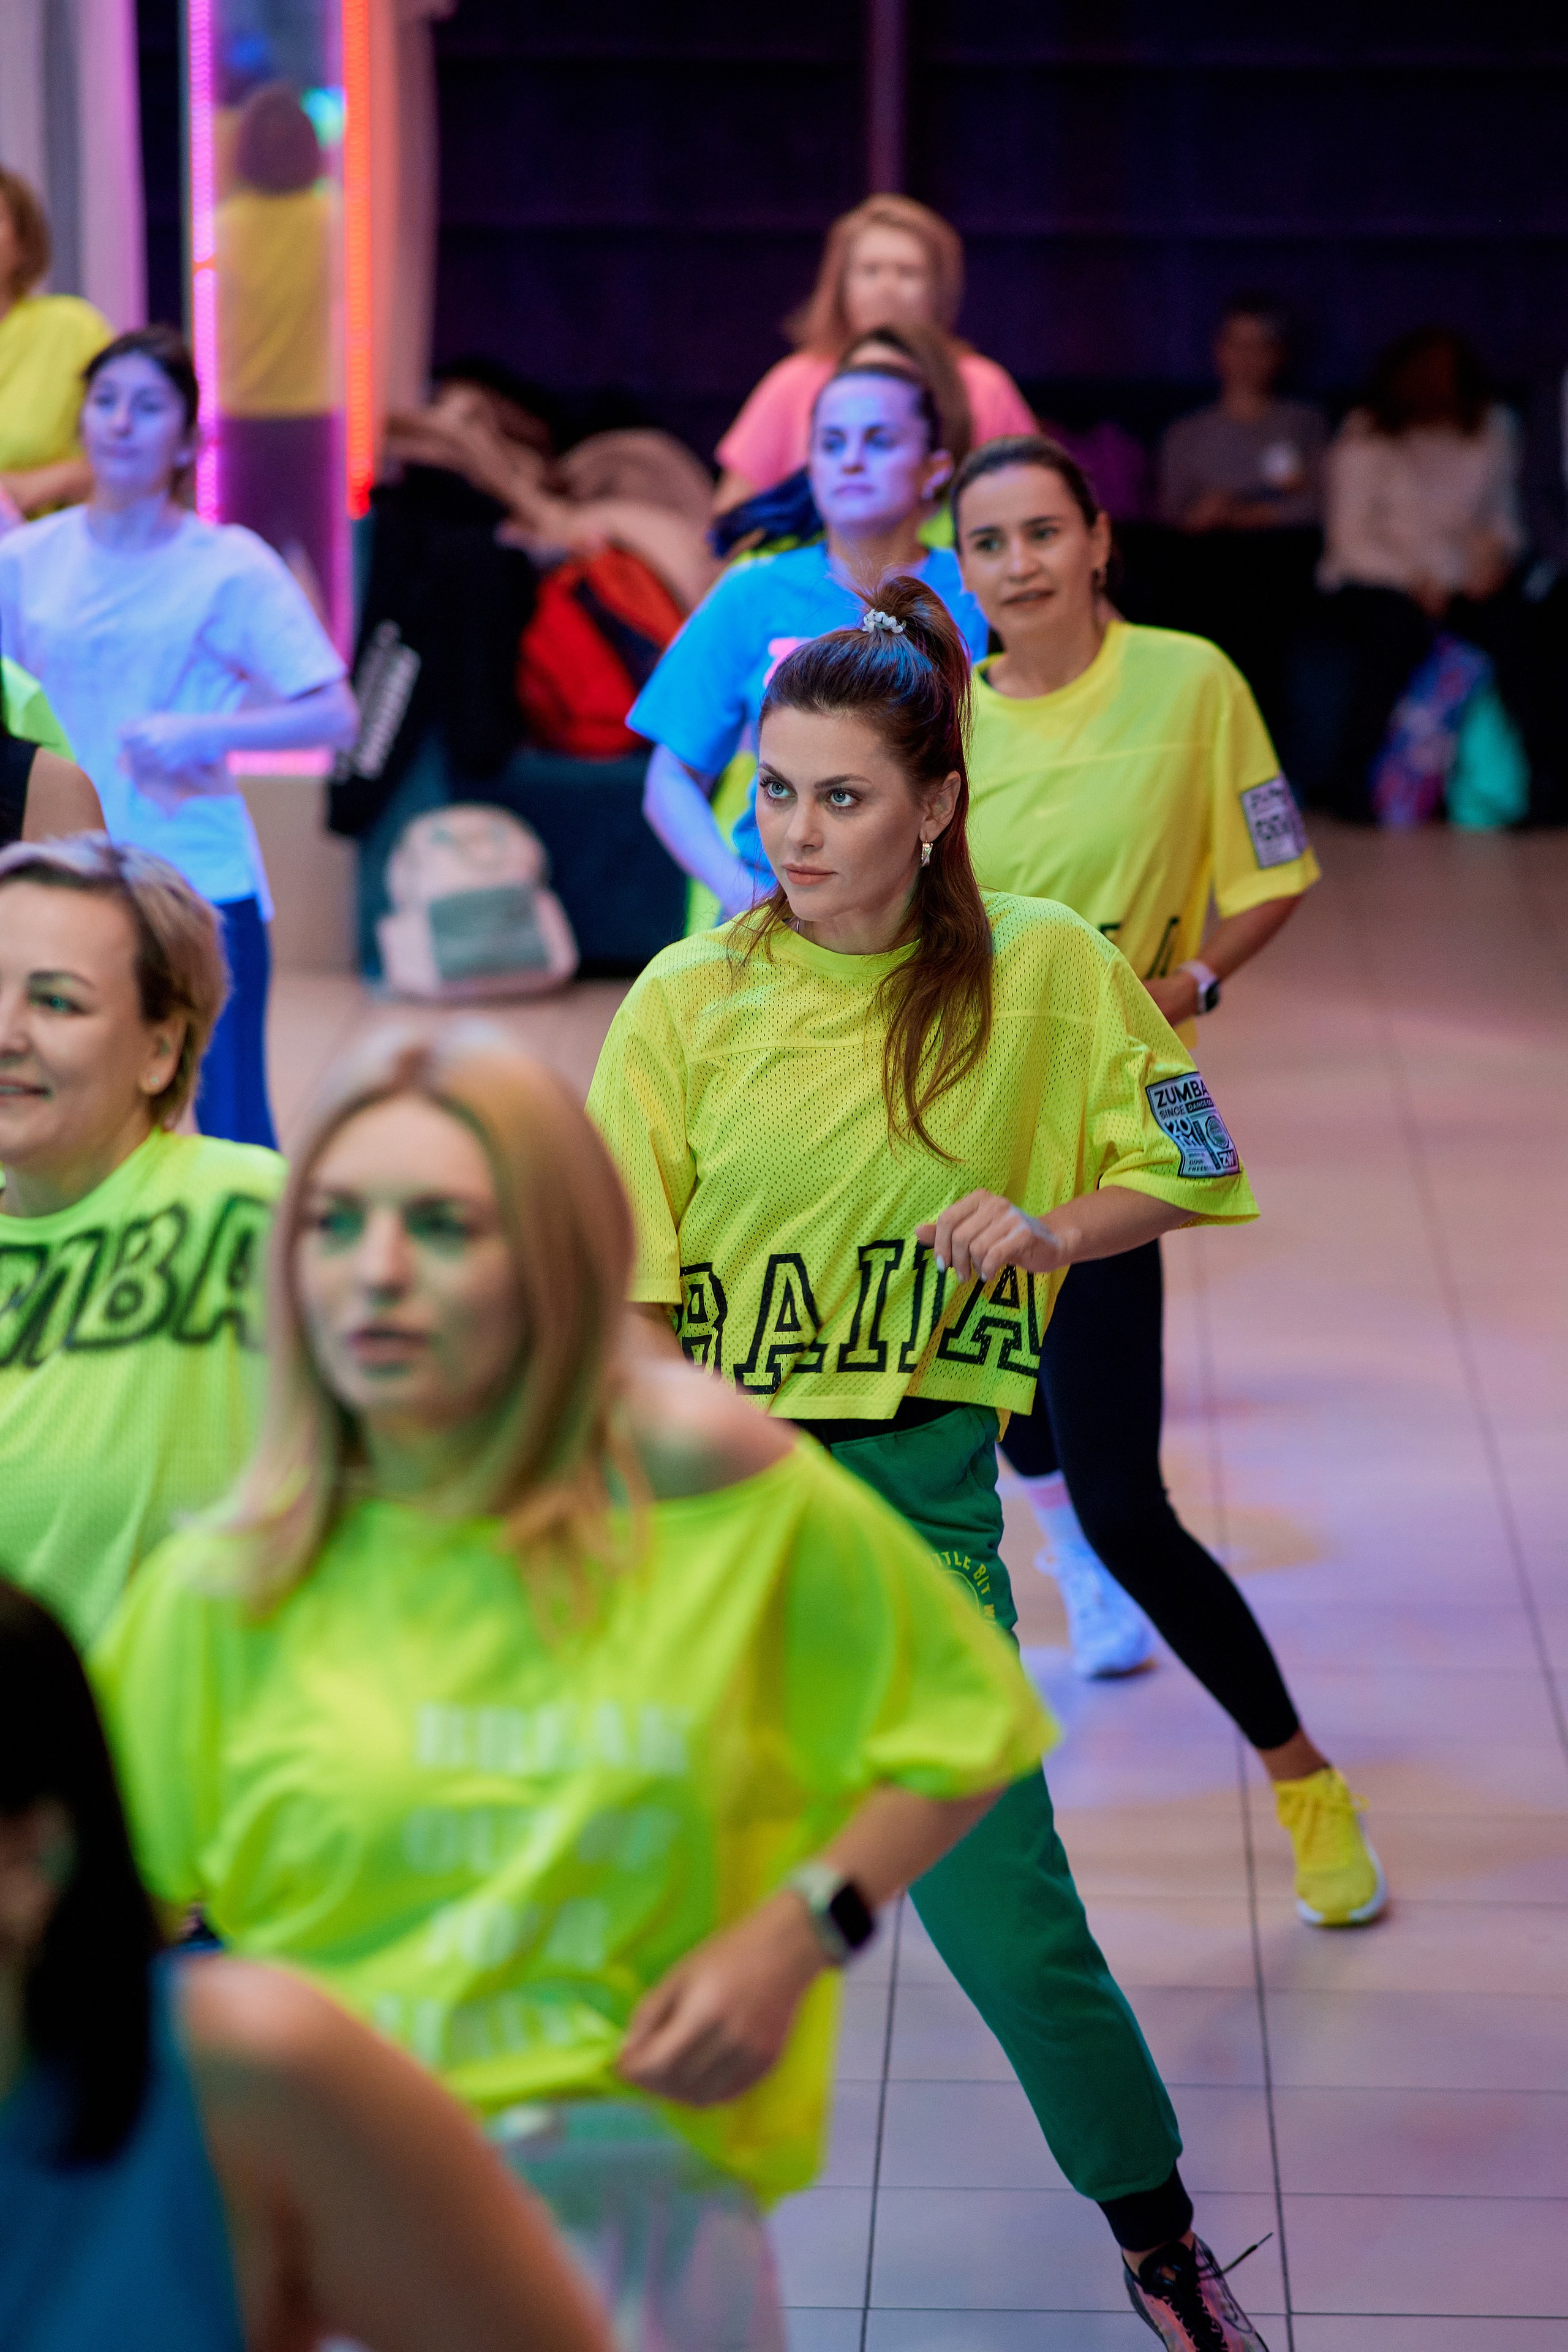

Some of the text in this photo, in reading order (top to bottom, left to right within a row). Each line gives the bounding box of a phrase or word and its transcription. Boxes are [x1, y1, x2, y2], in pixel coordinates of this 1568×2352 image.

[1155, 1080, 1210, 1107] ZUMBA
[1159, 1104, 1186, 1120] SINCE
[973, 1562, 991, 1594] BIT
